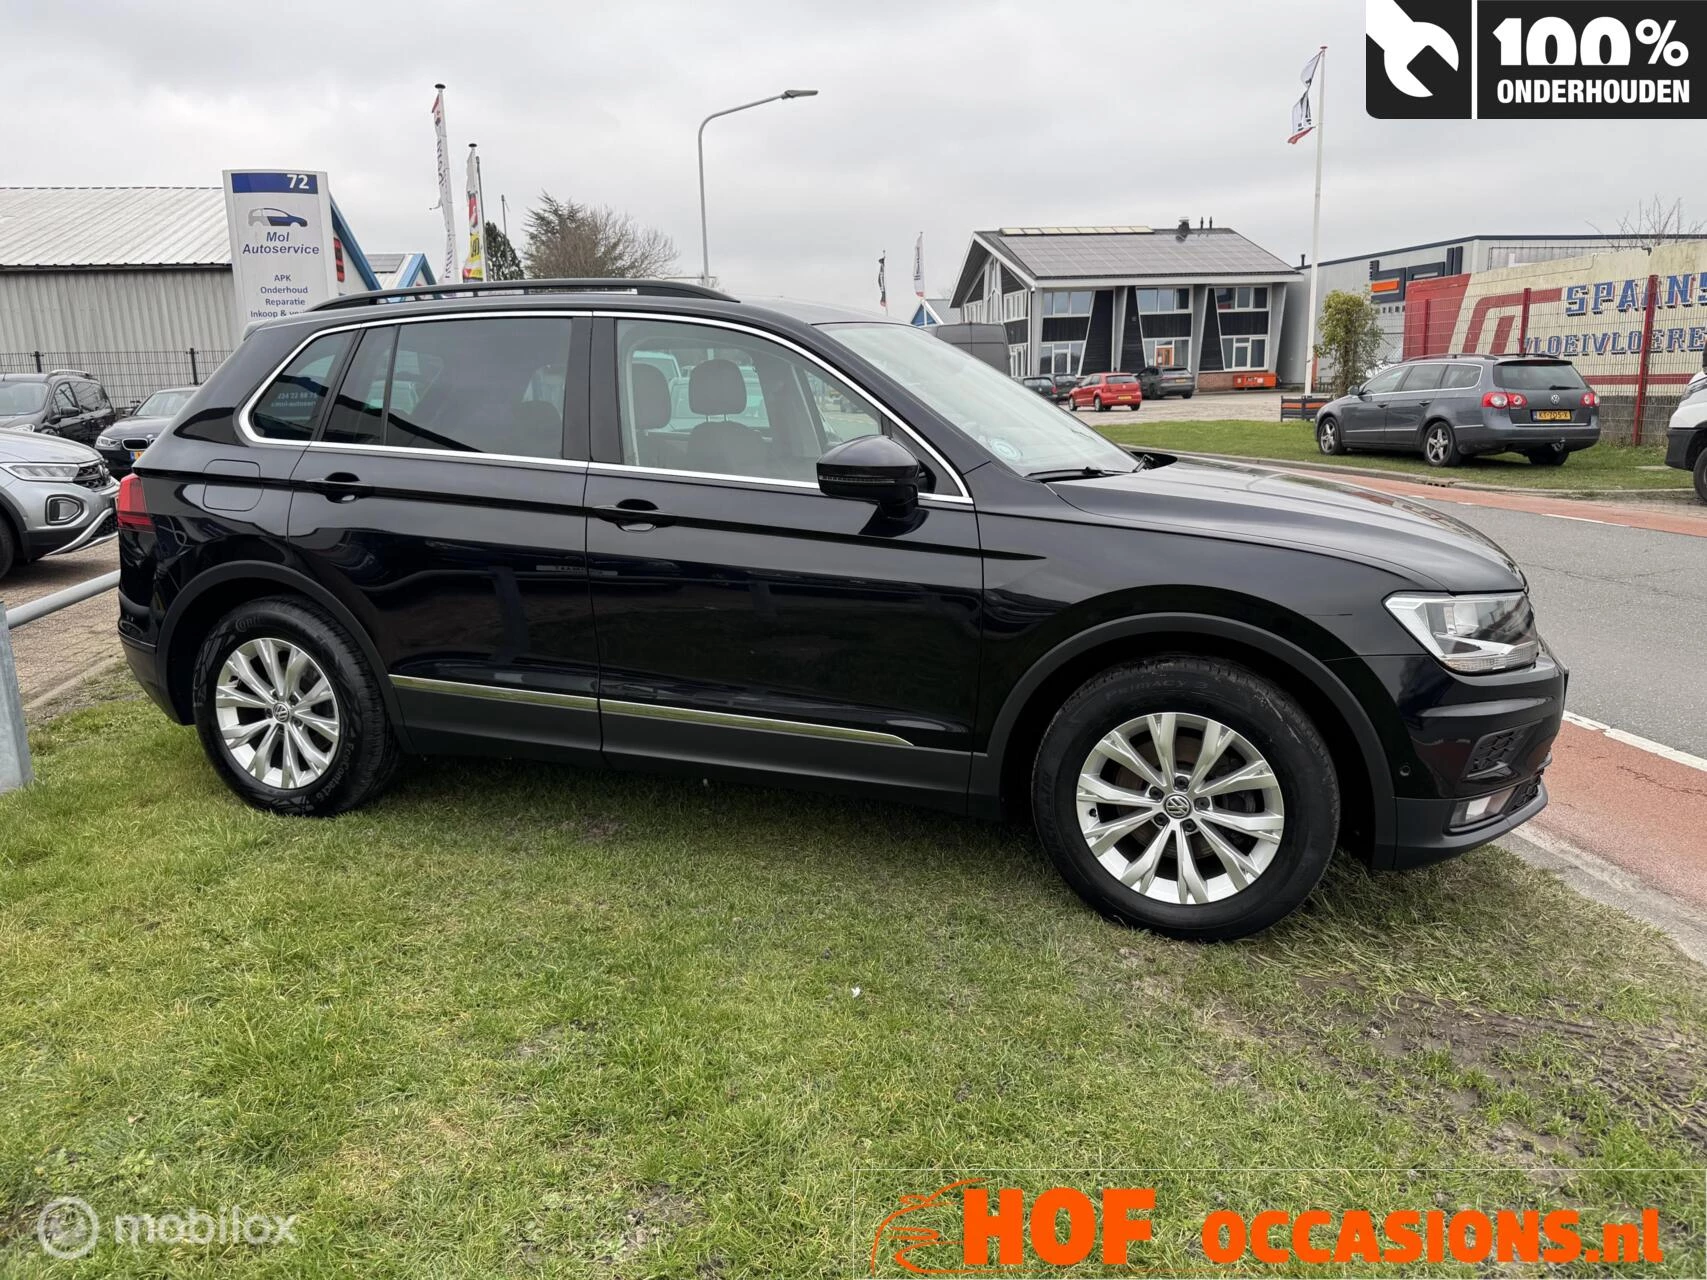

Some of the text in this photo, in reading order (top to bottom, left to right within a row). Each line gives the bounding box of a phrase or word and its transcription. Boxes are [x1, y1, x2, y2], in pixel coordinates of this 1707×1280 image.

[287, 174, 309, 189] 72
[266, 231, 290, 242] Mol
[242, 244, 320, 254] Autoservice
[260, 286, 308, 294] Onderhoud
[265, 298, 306, 307] Reparatie
[250, 310, 278, 319] Inkoop
